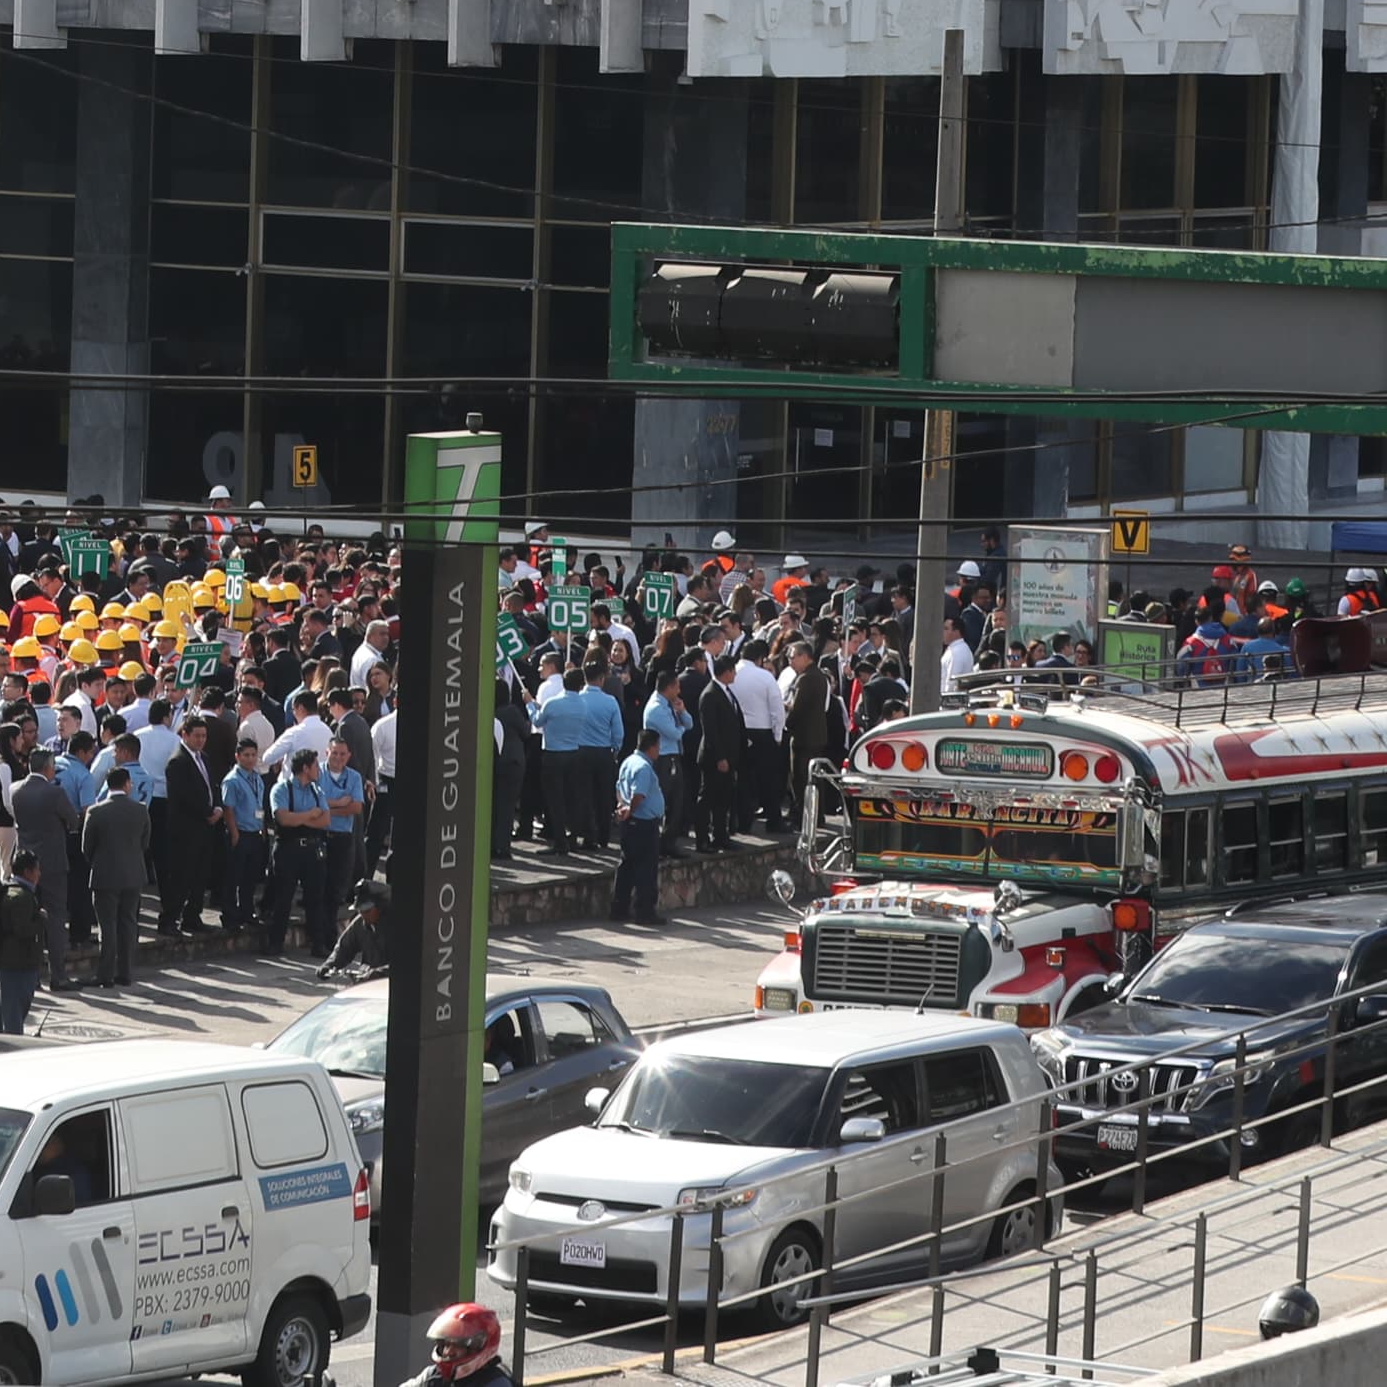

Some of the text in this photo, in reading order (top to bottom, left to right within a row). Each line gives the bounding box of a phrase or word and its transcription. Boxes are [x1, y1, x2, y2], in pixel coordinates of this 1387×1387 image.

[300, 451, 311, 481] 5
[79, 541, 102, 549] NIVEL
[225, 575, 242, 600] 06
[556, 587, 582, 596] NIVEL
[645, 587, 671, 614] 07
[550, 600, 588, 628] 05
[190, 645, 215, 654] NIVEL
[179, 657, 218, 684] 04
[436, 581, 465, 1022] BANCO DE GUATEMALA
[267, 1176, 307, 1192] SOLUCIONES
[139, 1219, 250, 1264] ECSSA
[137, 1258, 250, 1291] www.ecssa.com
[136, 1279, 251, 1318] PBX: 2379-9000
